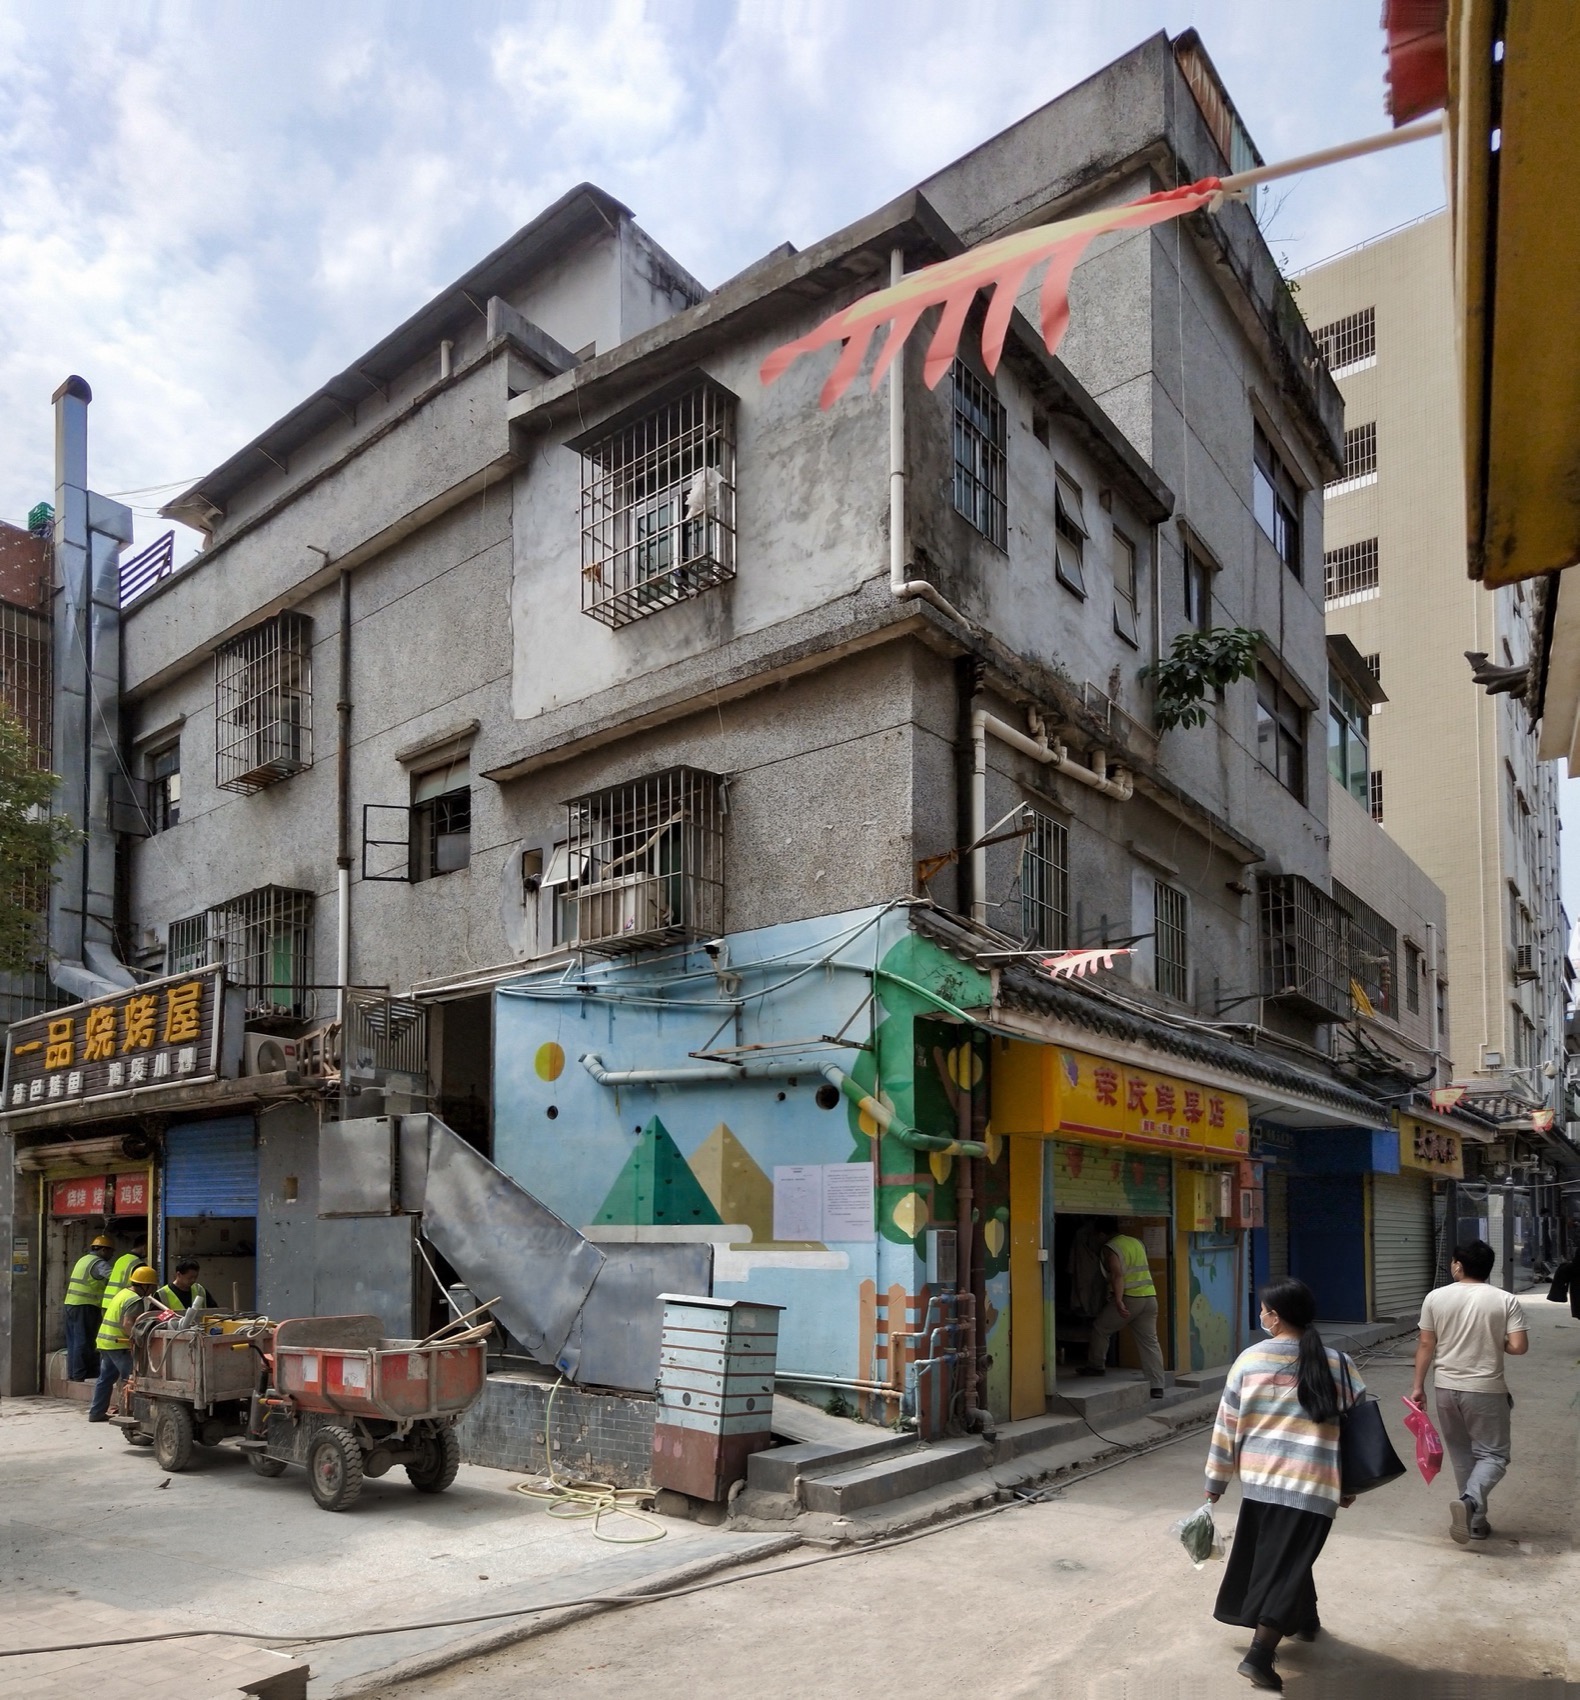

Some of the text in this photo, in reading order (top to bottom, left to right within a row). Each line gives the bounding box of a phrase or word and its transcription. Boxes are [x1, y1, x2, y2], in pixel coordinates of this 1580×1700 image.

[15, 981, 203, 1069] 一品烧烤屋
[66, 1188, 87, 1208] 烧烤
[120, 1184, 144, 1205] 鸡煲
